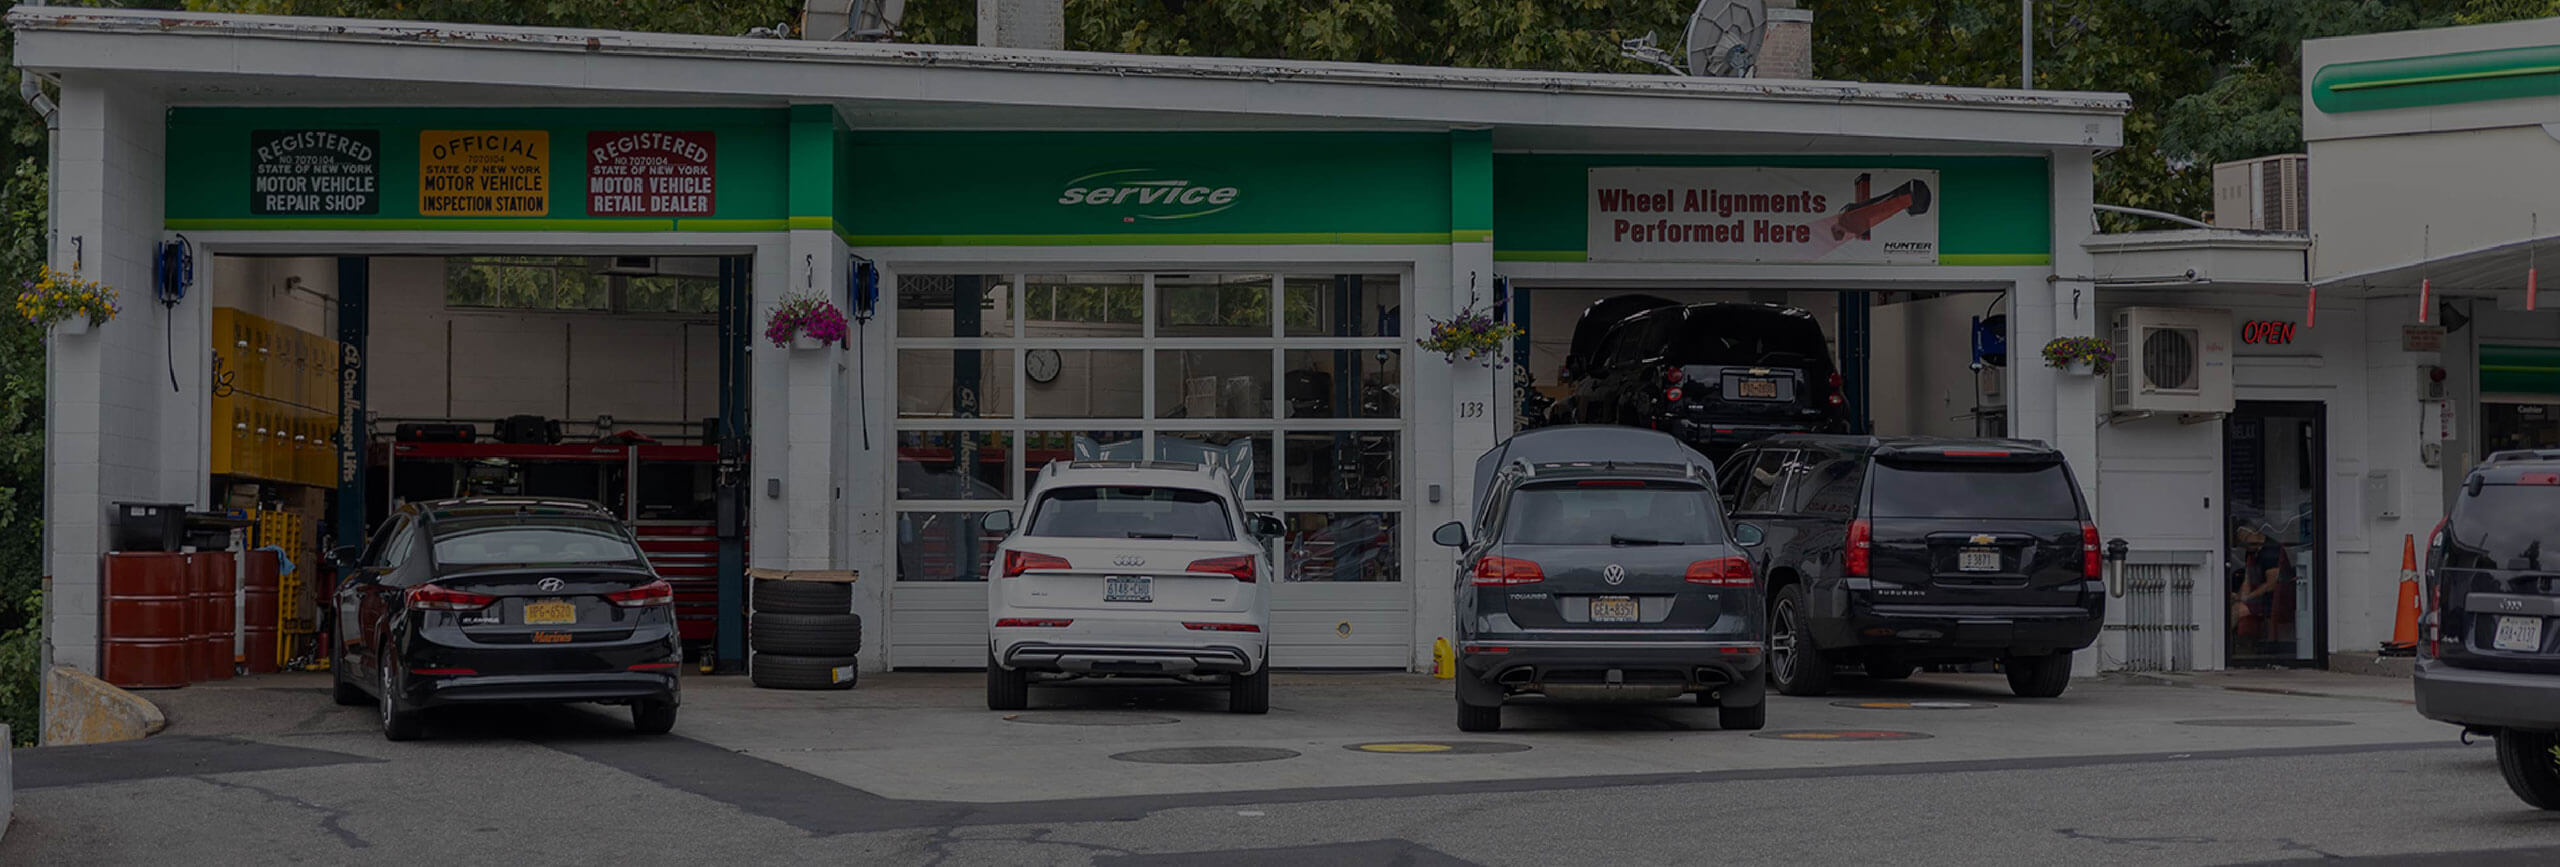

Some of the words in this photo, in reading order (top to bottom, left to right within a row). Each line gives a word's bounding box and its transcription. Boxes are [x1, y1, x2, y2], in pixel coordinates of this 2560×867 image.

[257, 131, 373, 163] REGISTERED
[433, 135, 538, 160] OFFICIAL
[593, 132, 708, 164] REGISTERED
[258, 164, 291, 174] STATE
[295, 164, 311, 174] OF
[313, 164, 341, 174] NEW
[342, 164, 373, 174] YORK
[426, 165, 459, 174] STATE
[464, 165, 477, 174] OF
[481, 165, 507, 174] NEW
[511, 165, 541, 174] YORK
[593, 165, 627, 175] STATE
[630, 165, 645, 175] OF
[649, 165, 674, 175] NEW
[678, 165, 708, 175] YORK
[256, 176, 307, 192] MOTOR
[311, 176, 375, 192] VEHICLE
[425, 176, 474, 191] MOTOR
[480, 176, 542, 191] VEHICLE
[590, 177, 644, 193] MOTOR
[649, 177, 711, 193] VEHICLE
[1058, 180, 1238, 205] service
[266, 194, 320, 211] REPAIR
[325, 194, 366, 211] SHOP
[423, 196, 492, 212] INSPECTION
[496, 196, 543, 212] STATION
[593, 195, 645, 212] RETAIL
[650, 195, 708, 212] DEALER
[1598, 189, 1673, 212] Wheel
[1683, 189, 1827, 217] Alignments
[1614, 219, 1744, 242] Performed
[1753, 219, 1810, 242] Here
[2242, 320, 2296, 344] OPEN
[1460, 402, 1484, 418] 133
